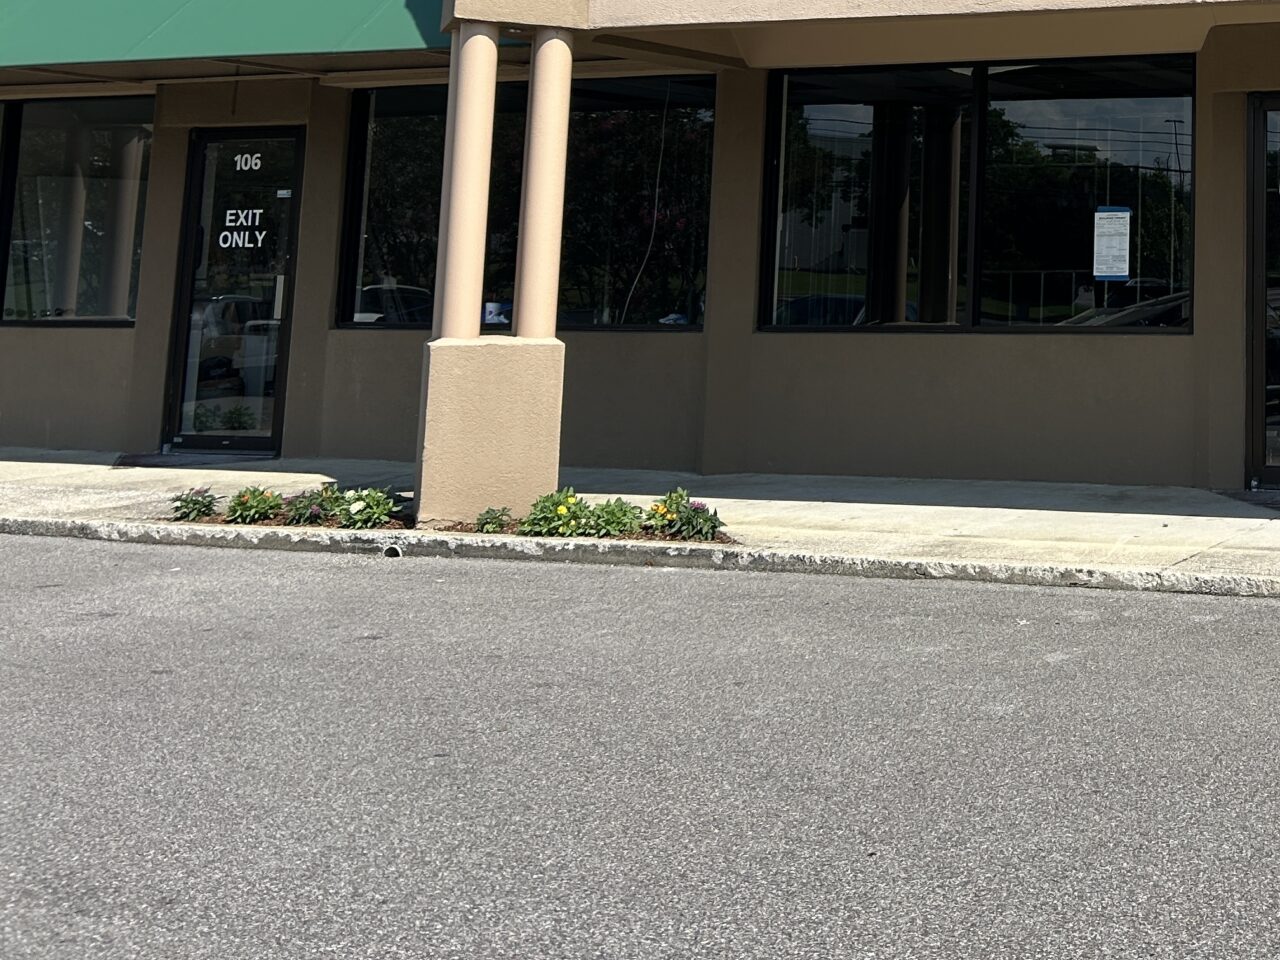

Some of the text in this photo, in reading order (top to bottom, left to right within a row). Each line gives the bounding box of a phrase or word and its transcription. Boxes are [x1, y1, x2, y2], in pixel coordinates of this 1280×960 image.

[234, 153, 262, 171] 106
[225, 209, 264, 226] EXIT
[219, 230, 267, 248] ONLY
